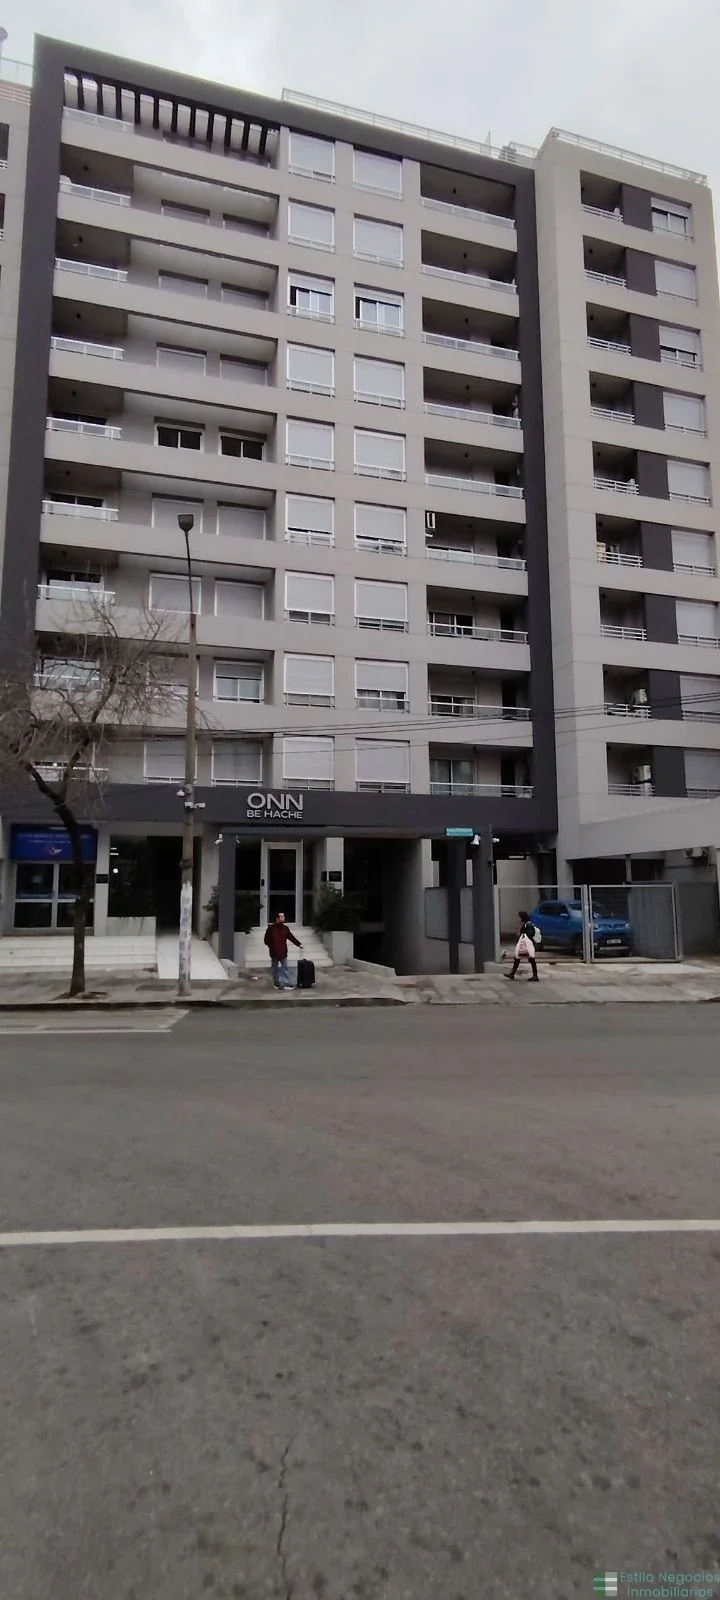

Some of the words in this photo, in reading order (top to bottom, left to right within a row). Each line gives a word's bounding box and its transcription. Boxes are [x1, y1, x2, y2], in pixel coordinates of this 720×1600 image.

[247, 792, 304, 811] ONN
[246, 809, 262, 818] BE
[264, 810, 303, 819] HACHE
